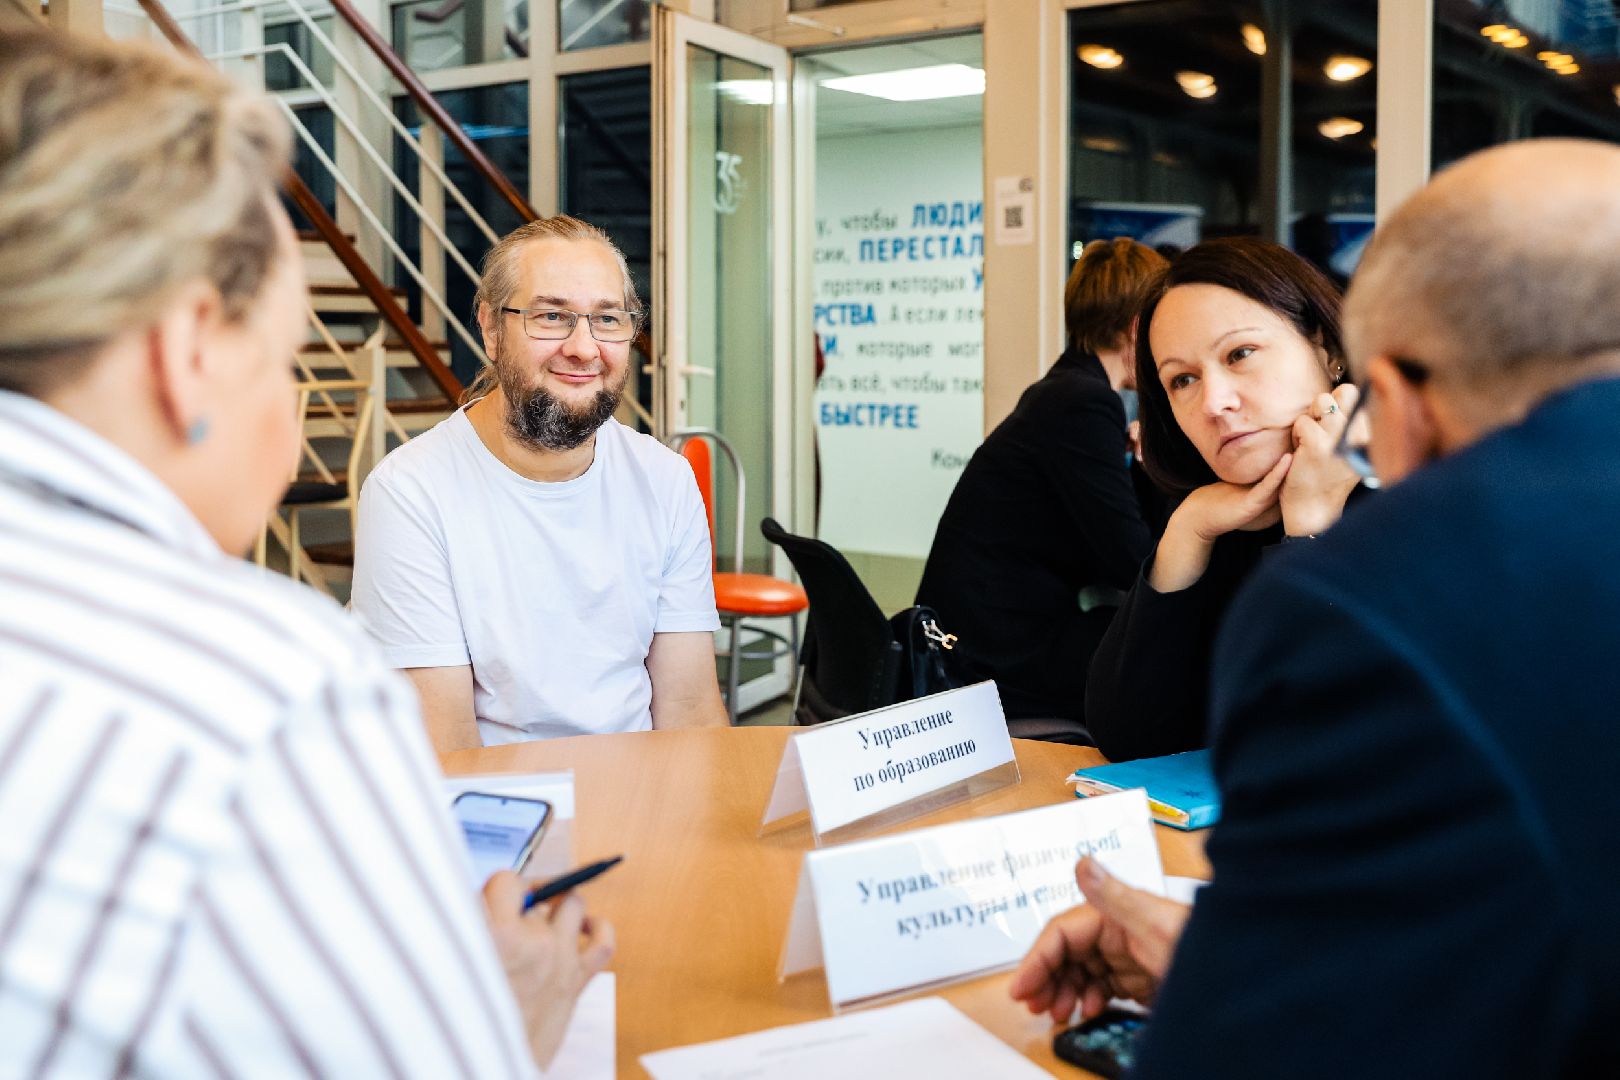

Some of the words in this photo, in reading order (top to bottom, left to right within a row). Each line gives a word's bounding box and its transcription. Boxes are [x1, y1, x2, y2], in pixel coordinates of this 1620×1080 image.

[841, 208, 898, 232] чтобы
[912, 201, 984, 229] ЛЮДИ
[858, 234, 984, 263] ПЕРЕСТАЛ
[822, 278, 883, 298] против
[890, 275, 965, 296] которых
[905, 308, 947, 322] если
[856, 341, 933, 362] которые
[891, 372, 946, 393] чтобы
[819, 402, 919, 428] БЫСТРЕЕ
[857, 709, 953, 750] Управление
[853, 773, 875, 792] по
[878, 739, 976, 784] образованию
[857, 858, 997, 903] Управление
[1001, 830, 1120, 880] физичской
[896, 899, 1009, 939] культуры
[1014, 889, 1029, 909] и
